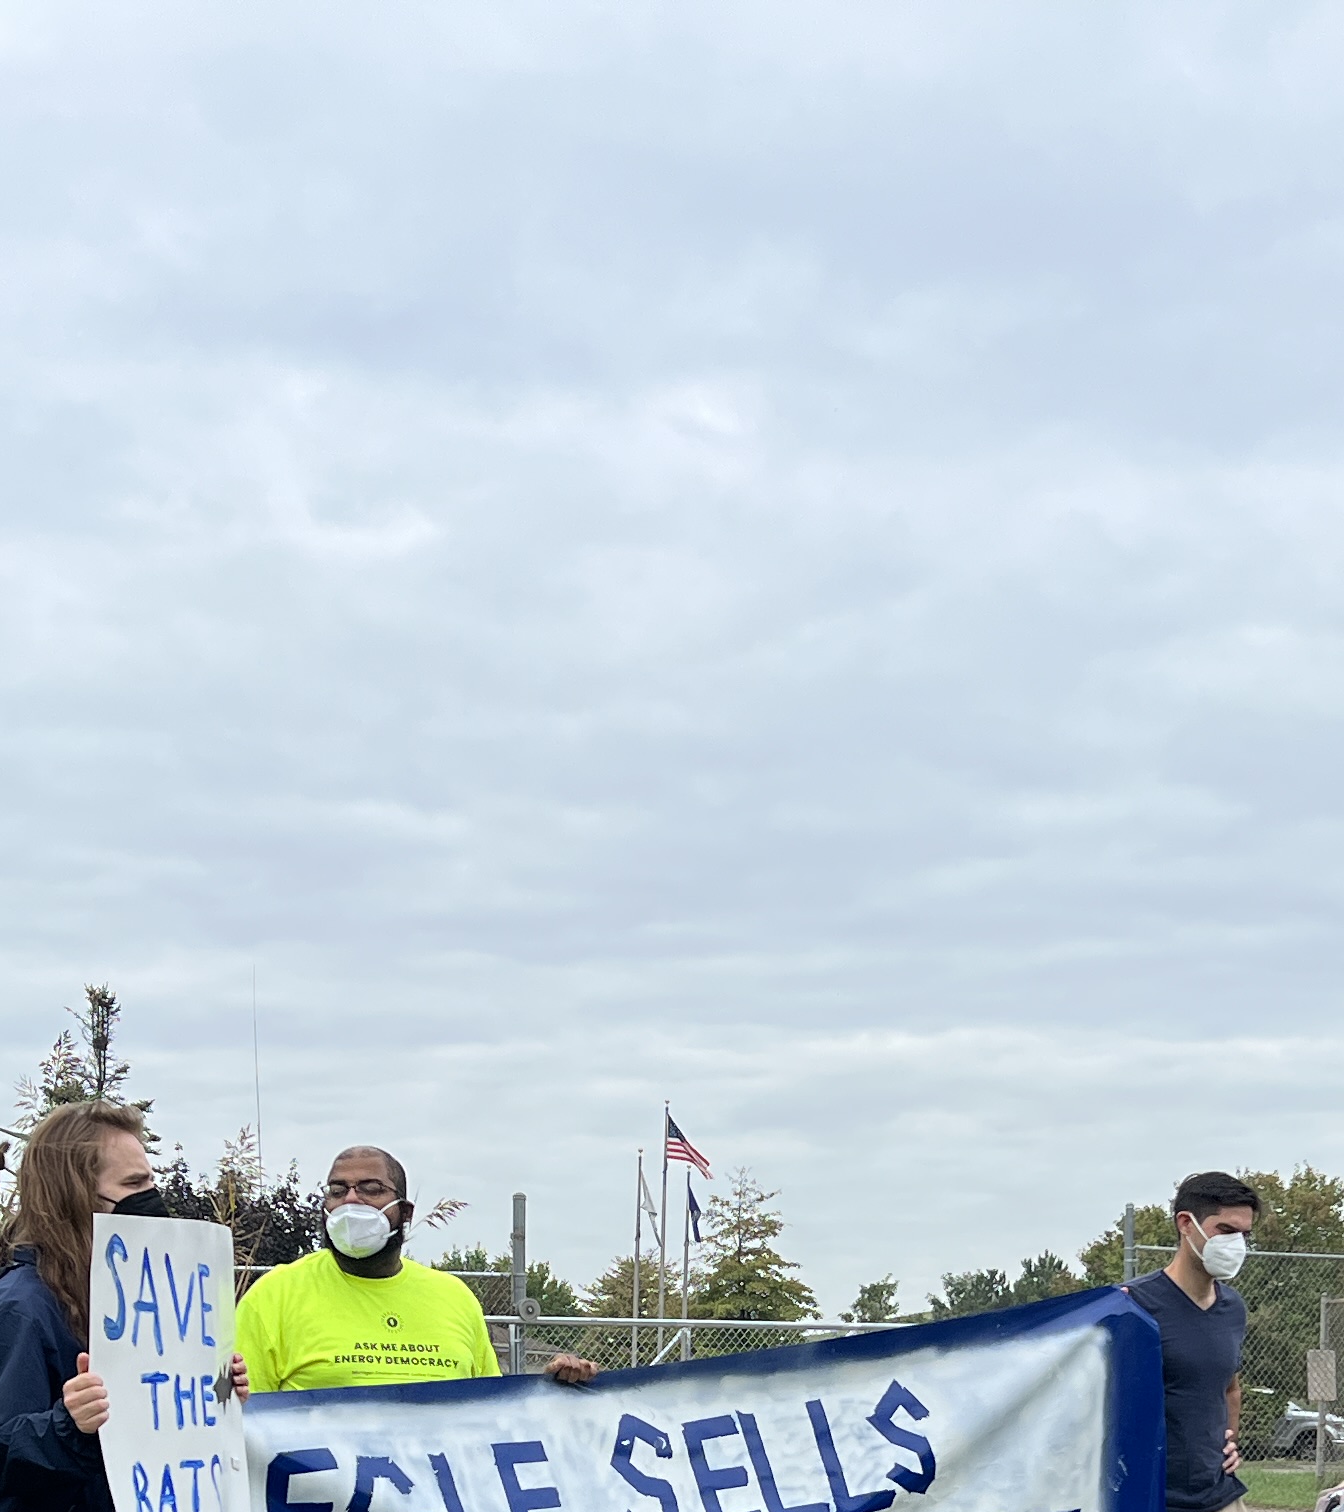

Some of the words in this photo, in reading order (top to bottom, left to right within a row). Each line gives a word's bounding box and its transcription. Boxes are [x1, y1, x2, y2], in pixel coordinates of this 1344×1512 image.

[104, 1233, 216, 1356] SAVE
[334, 1355, 382, 1365] ENERGY
[385, 1356, 459, 1369] DEMOCRACY
[354, 1342, 378, 1351] ASK
[380, 1342, 398, 1352] ME
[400, 1343, 440, 1353] ABOUT
[141, 1371, 217, 1431] THE
